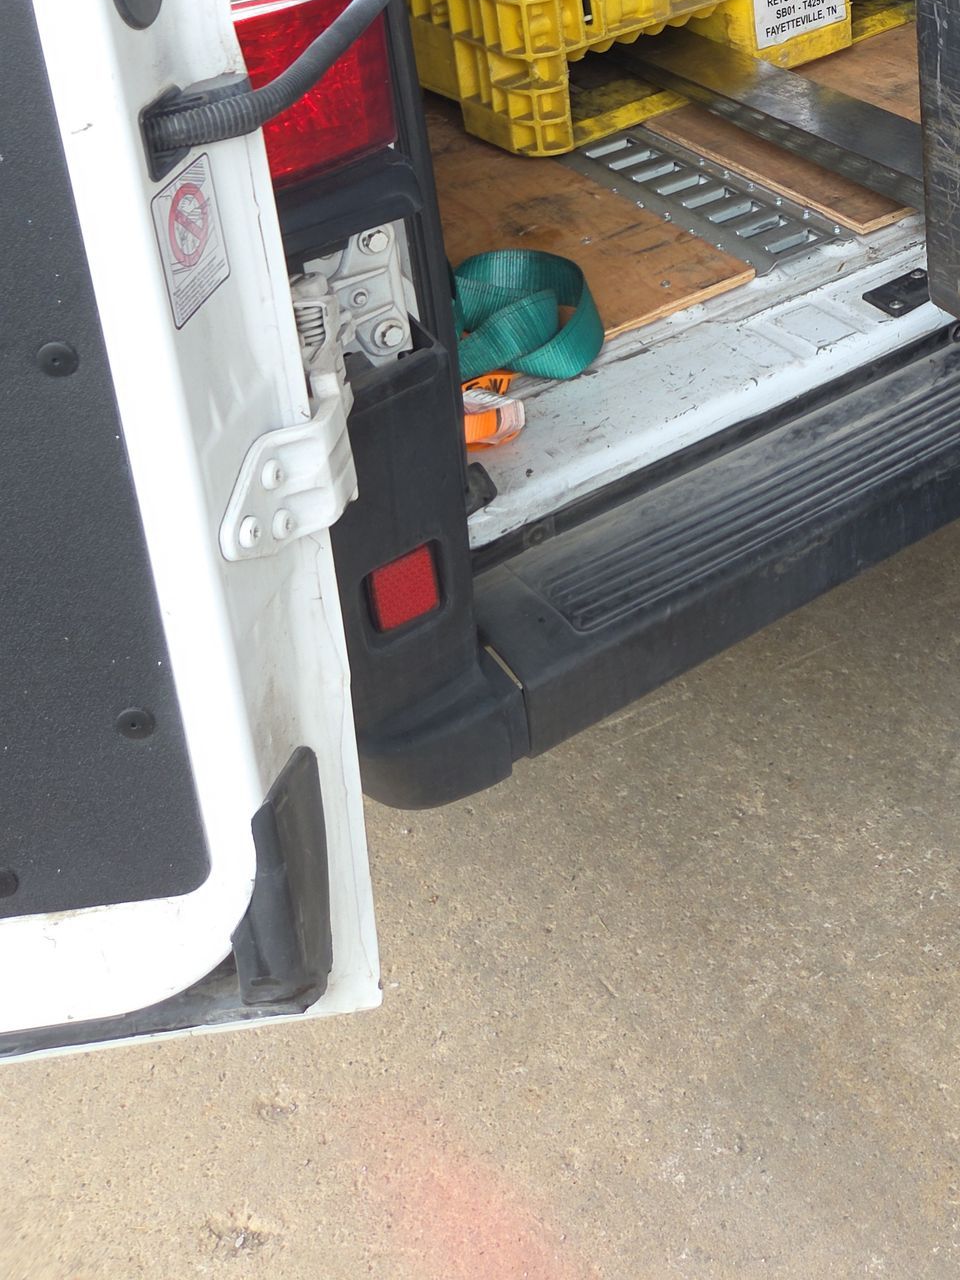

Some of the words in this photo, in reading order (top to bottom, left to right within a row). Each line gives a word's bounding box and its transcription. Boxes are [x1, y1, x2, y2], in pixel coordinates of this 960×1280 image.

[765, 9, 826, 38] FAYETTEVILLE,
[826, 4, 838, 17] TN
[776, 4, 796, 20] SB01
